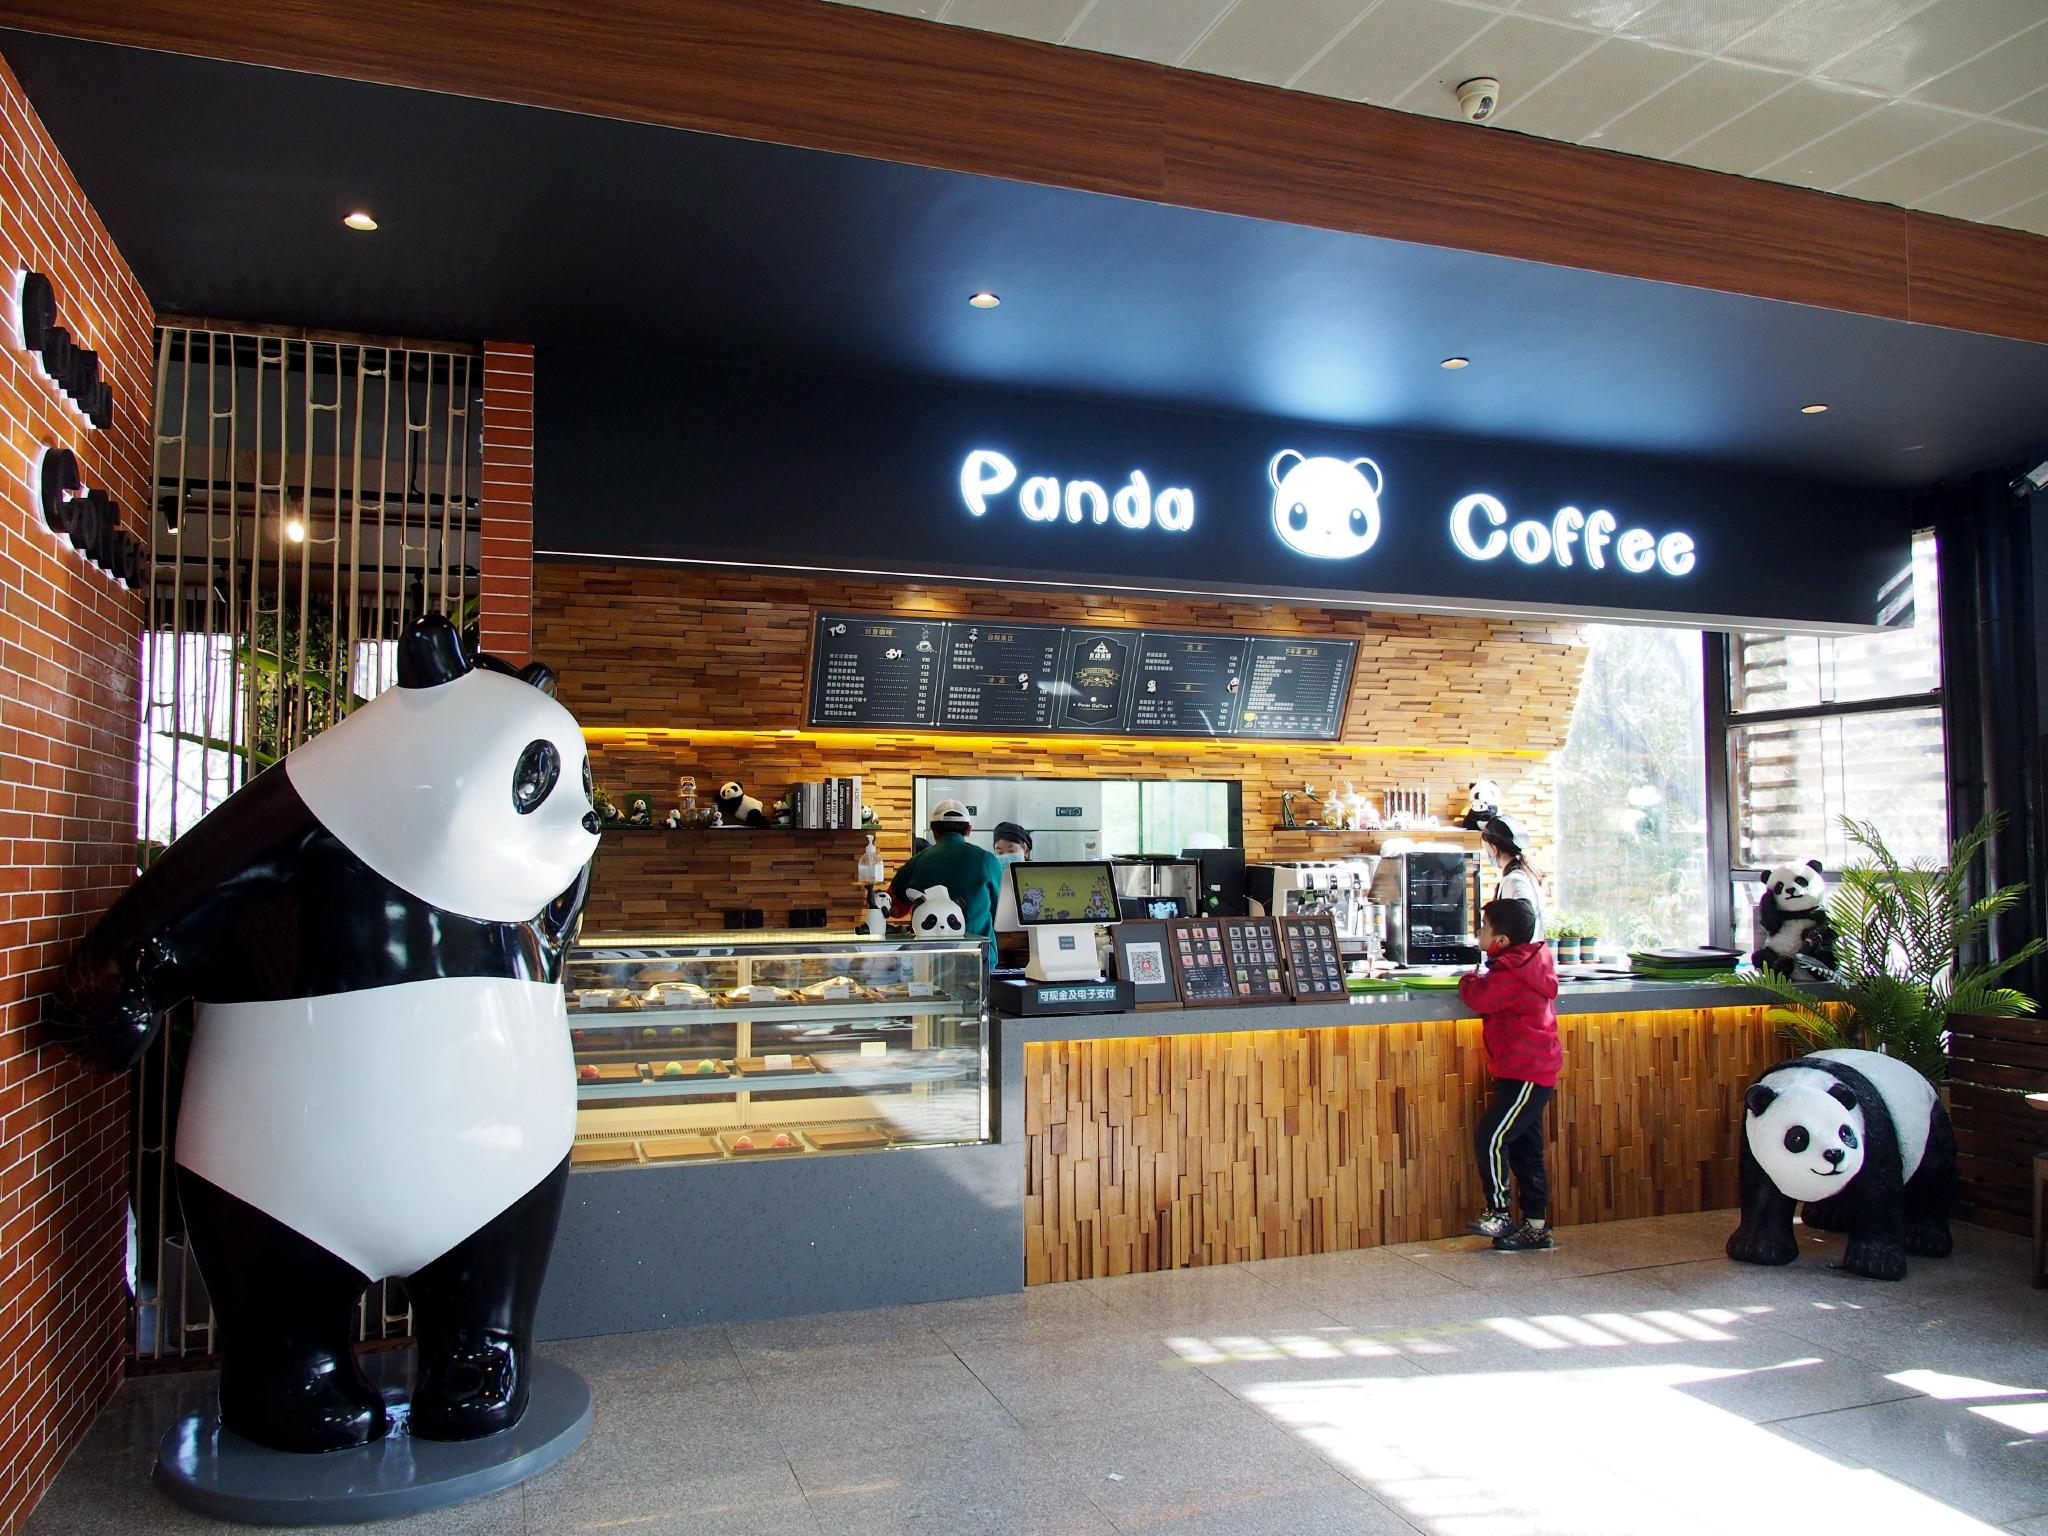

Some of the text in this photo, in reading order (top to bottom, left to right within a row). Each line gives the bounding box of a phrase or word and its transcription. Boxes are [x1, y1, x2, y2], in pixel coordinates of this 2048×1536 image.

[962, 451, 1695, 575] Panda Coffee
[1039, 988, 1115, 1002] 可现金及电子支付
